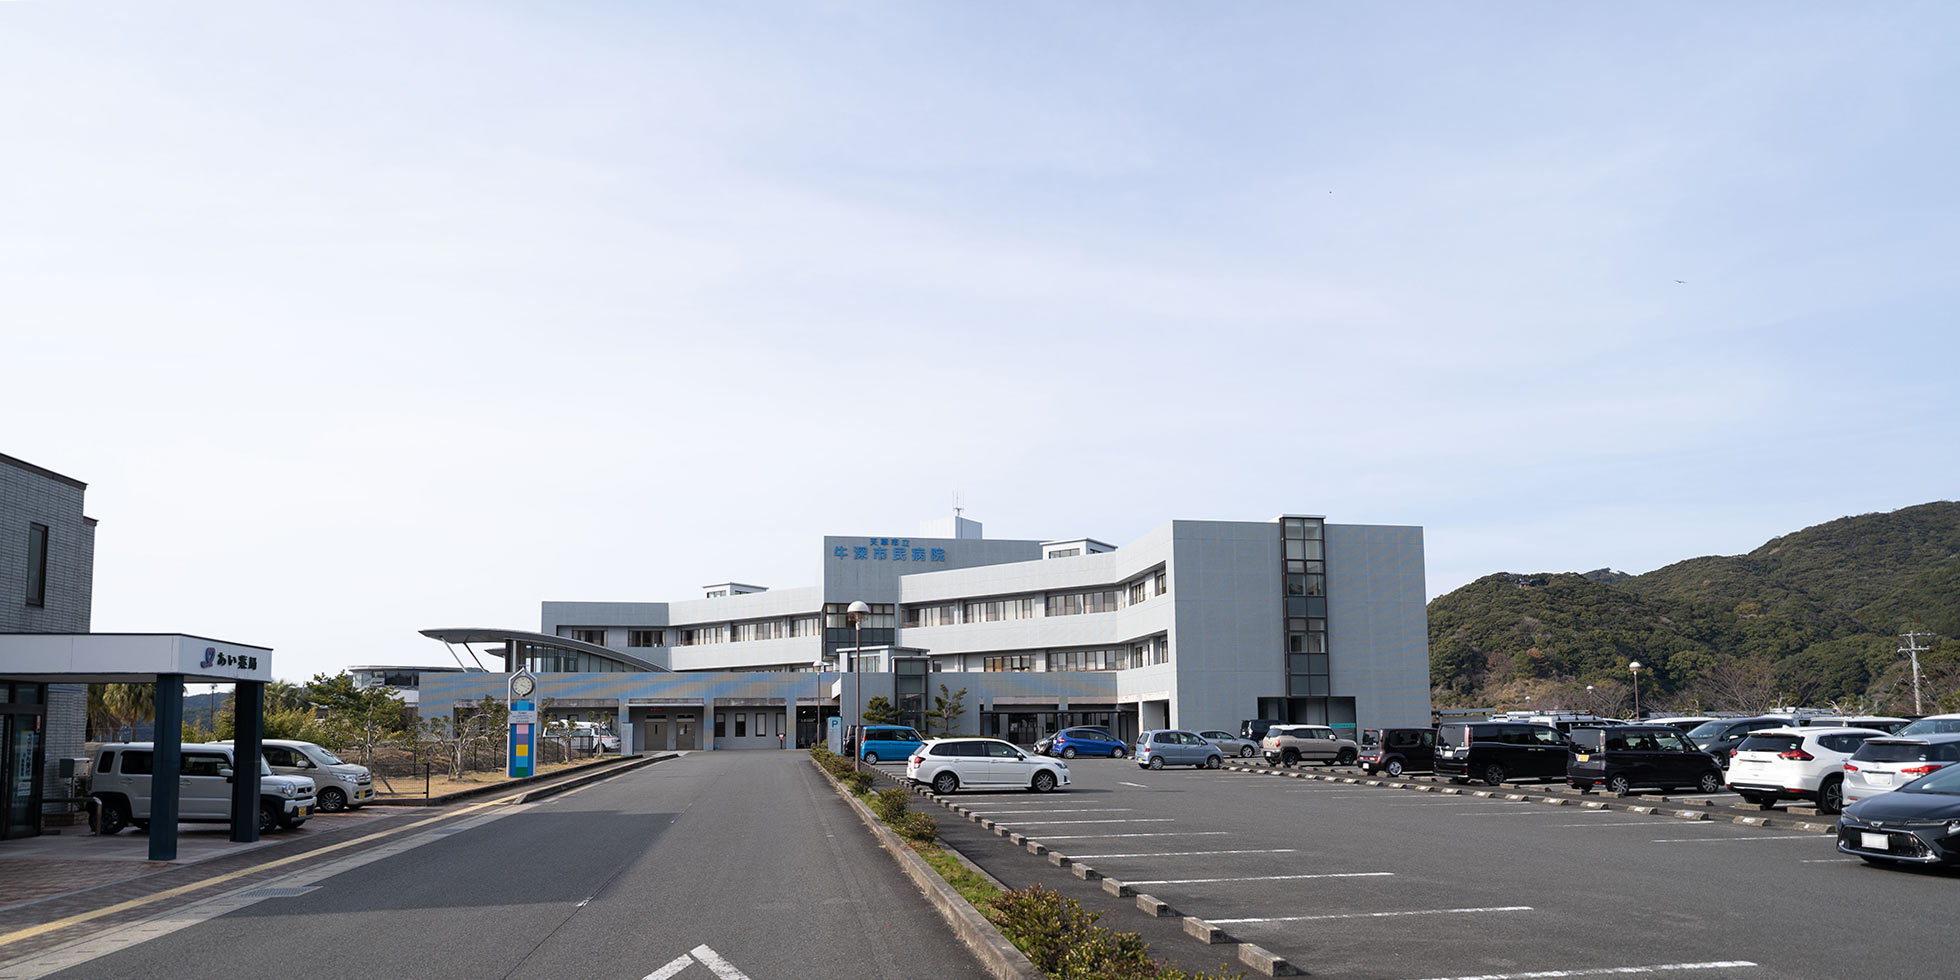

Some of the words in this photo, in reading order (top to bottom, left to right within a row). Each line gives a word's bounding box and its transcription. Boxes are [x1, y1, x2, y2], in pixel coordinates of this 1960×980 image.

[834, 546, 945, 561] 牛深市民病院
[217, 652, 257, 670] あい薬局
[831, 719, 839, 728] P
